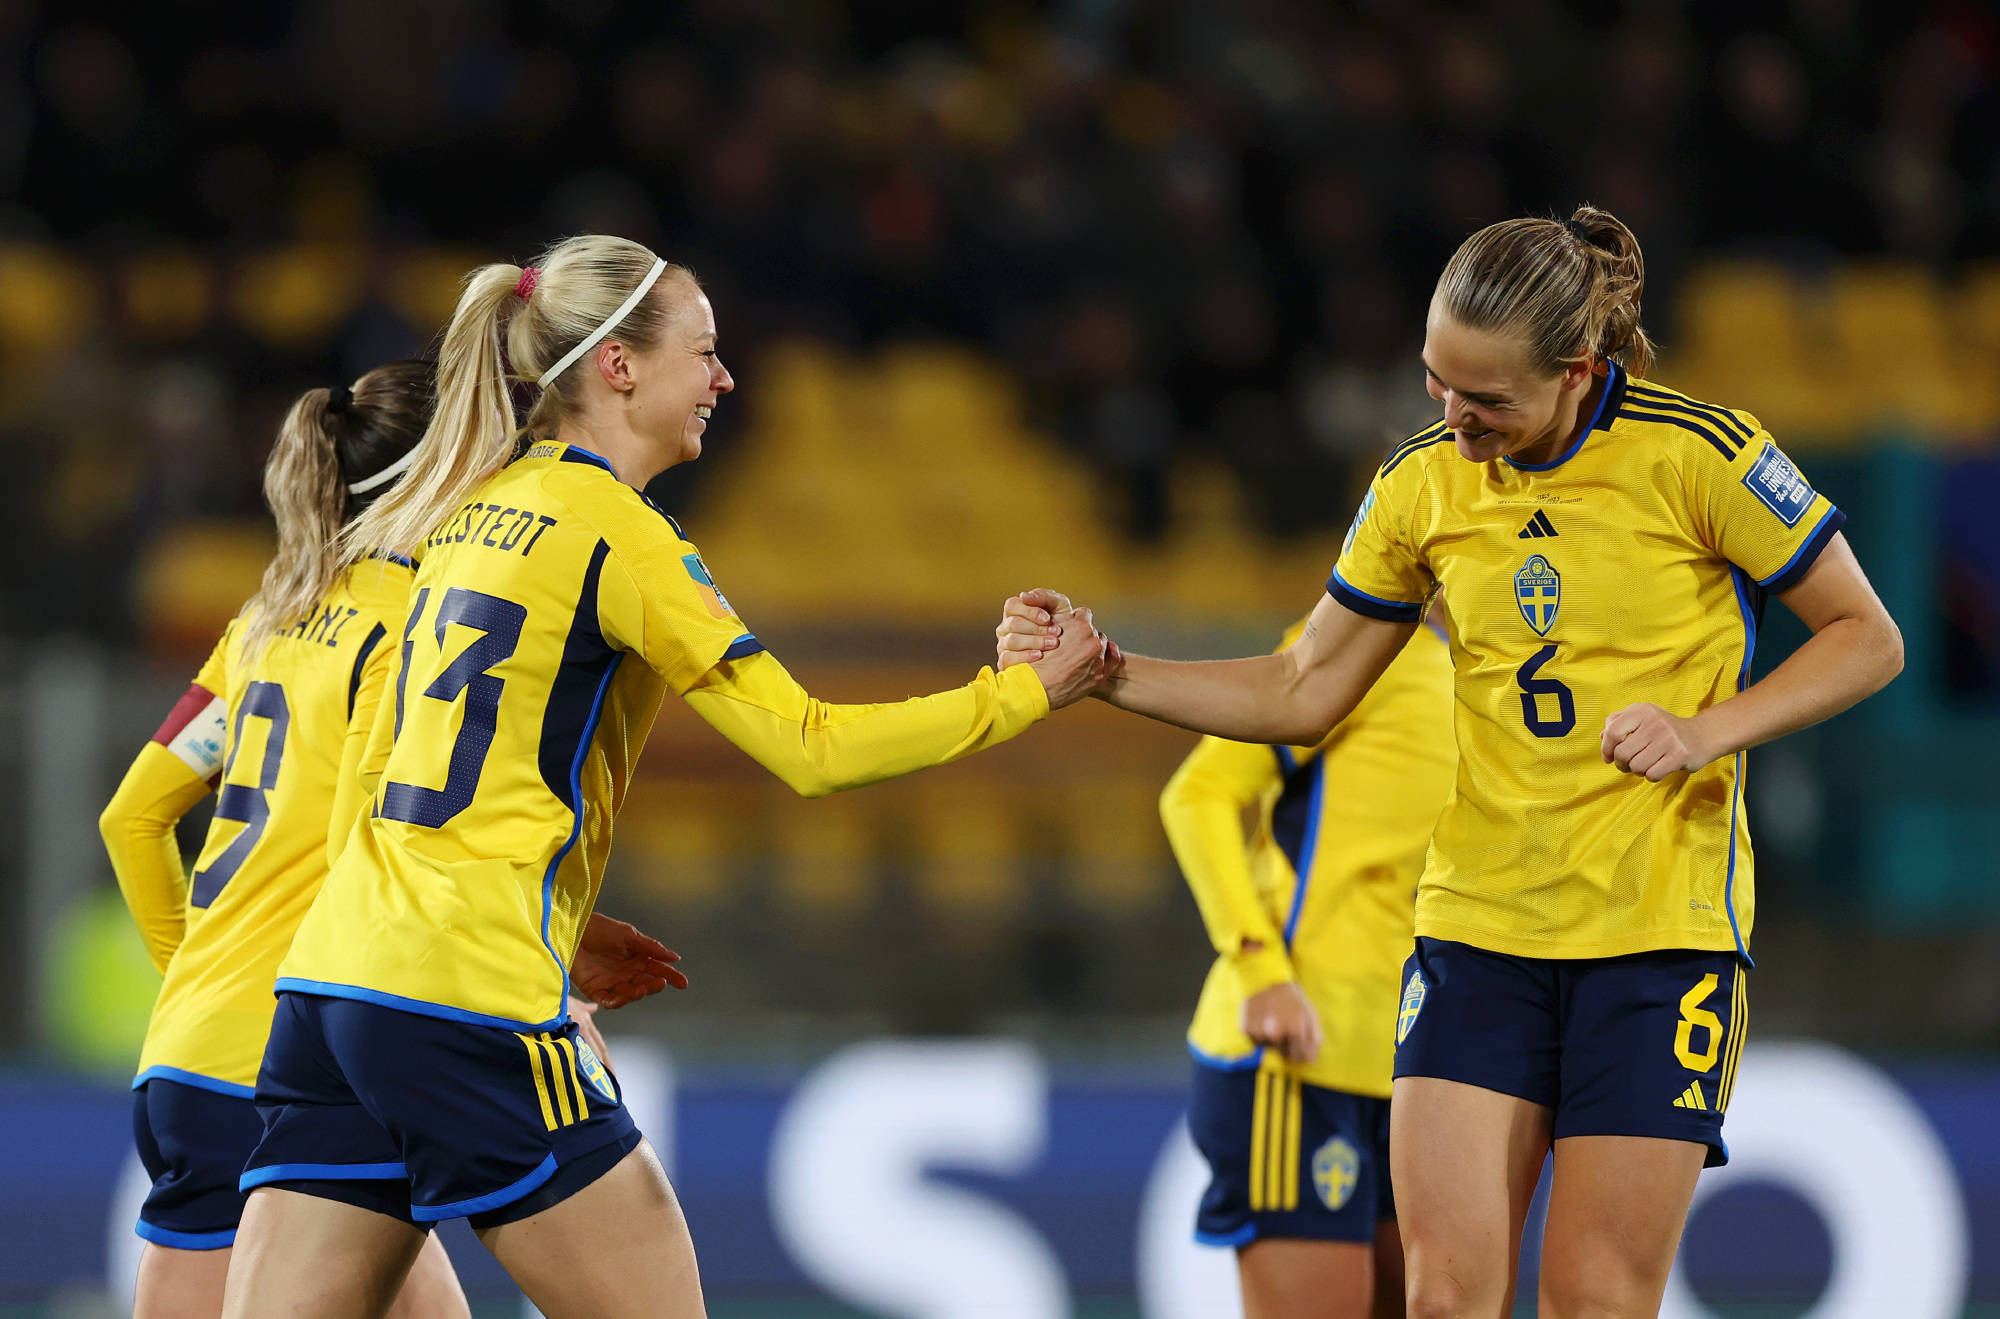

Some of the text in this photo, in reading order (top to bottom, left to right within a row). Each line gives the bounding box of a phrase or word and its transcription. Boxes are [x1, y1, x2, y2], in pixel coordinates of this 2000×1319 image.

[1759, 454, 1781, 484] FOOTBALL
[1766, 461, 1791, 493] UNITES
[372, 586, 527, 829] 13
[1517, 645, 1576, 738] 6
[191, 680, 290, 909] 9
[1674, 973, 1723, 1073] 6
